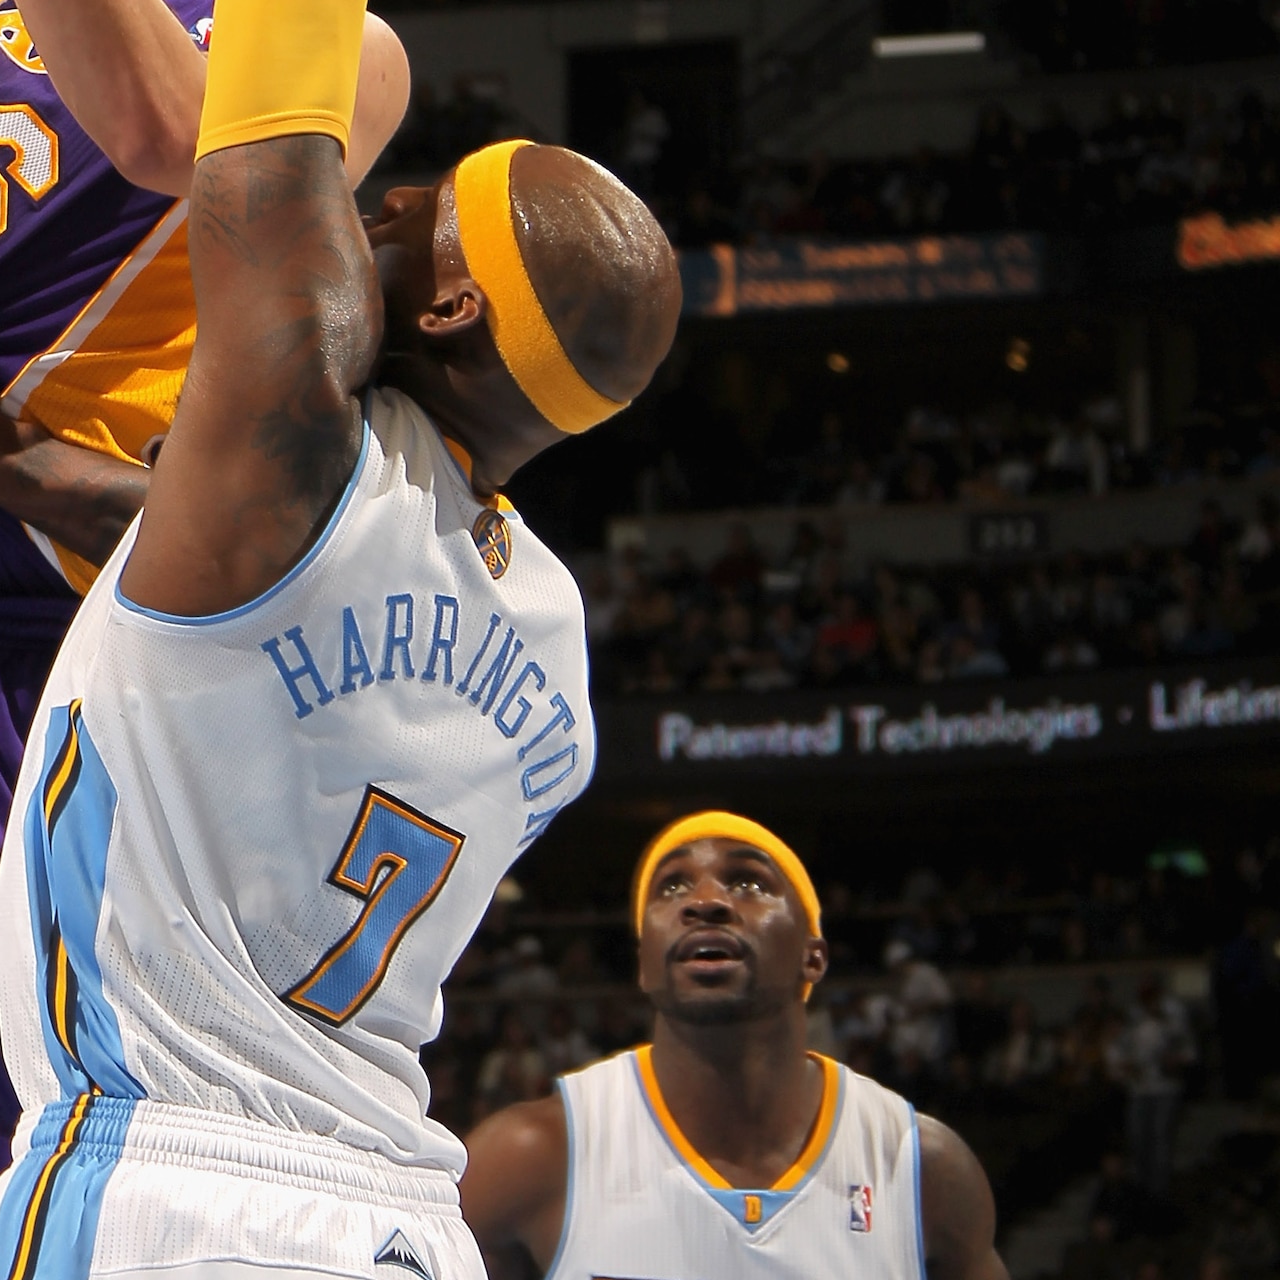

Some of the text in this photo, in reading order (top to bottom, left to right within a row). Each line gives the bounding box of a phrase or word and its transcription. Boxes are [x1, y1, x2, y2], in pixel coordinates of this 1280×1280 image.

[658, 708, 841, 761] Patented
[851, 694, 1100, 753] Technologies
[281, 782, 466, 1028] 7
